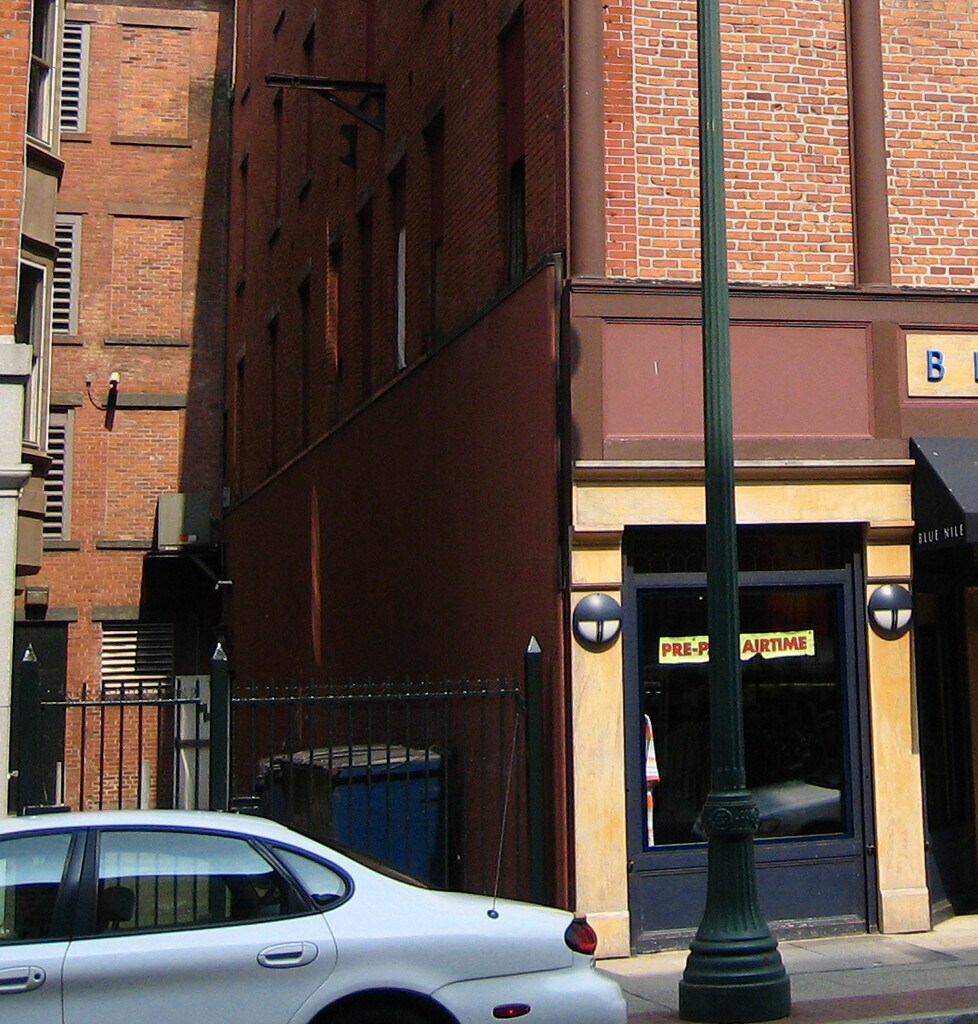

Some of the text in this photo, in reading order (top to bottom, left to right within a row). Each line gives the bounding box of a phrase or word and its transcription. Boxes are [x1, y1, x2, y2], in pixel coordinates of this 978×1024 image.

[918, 523, 964, 545] BLUE NILE
[661, 636, 807, 658] PRE-P AIRTIME
